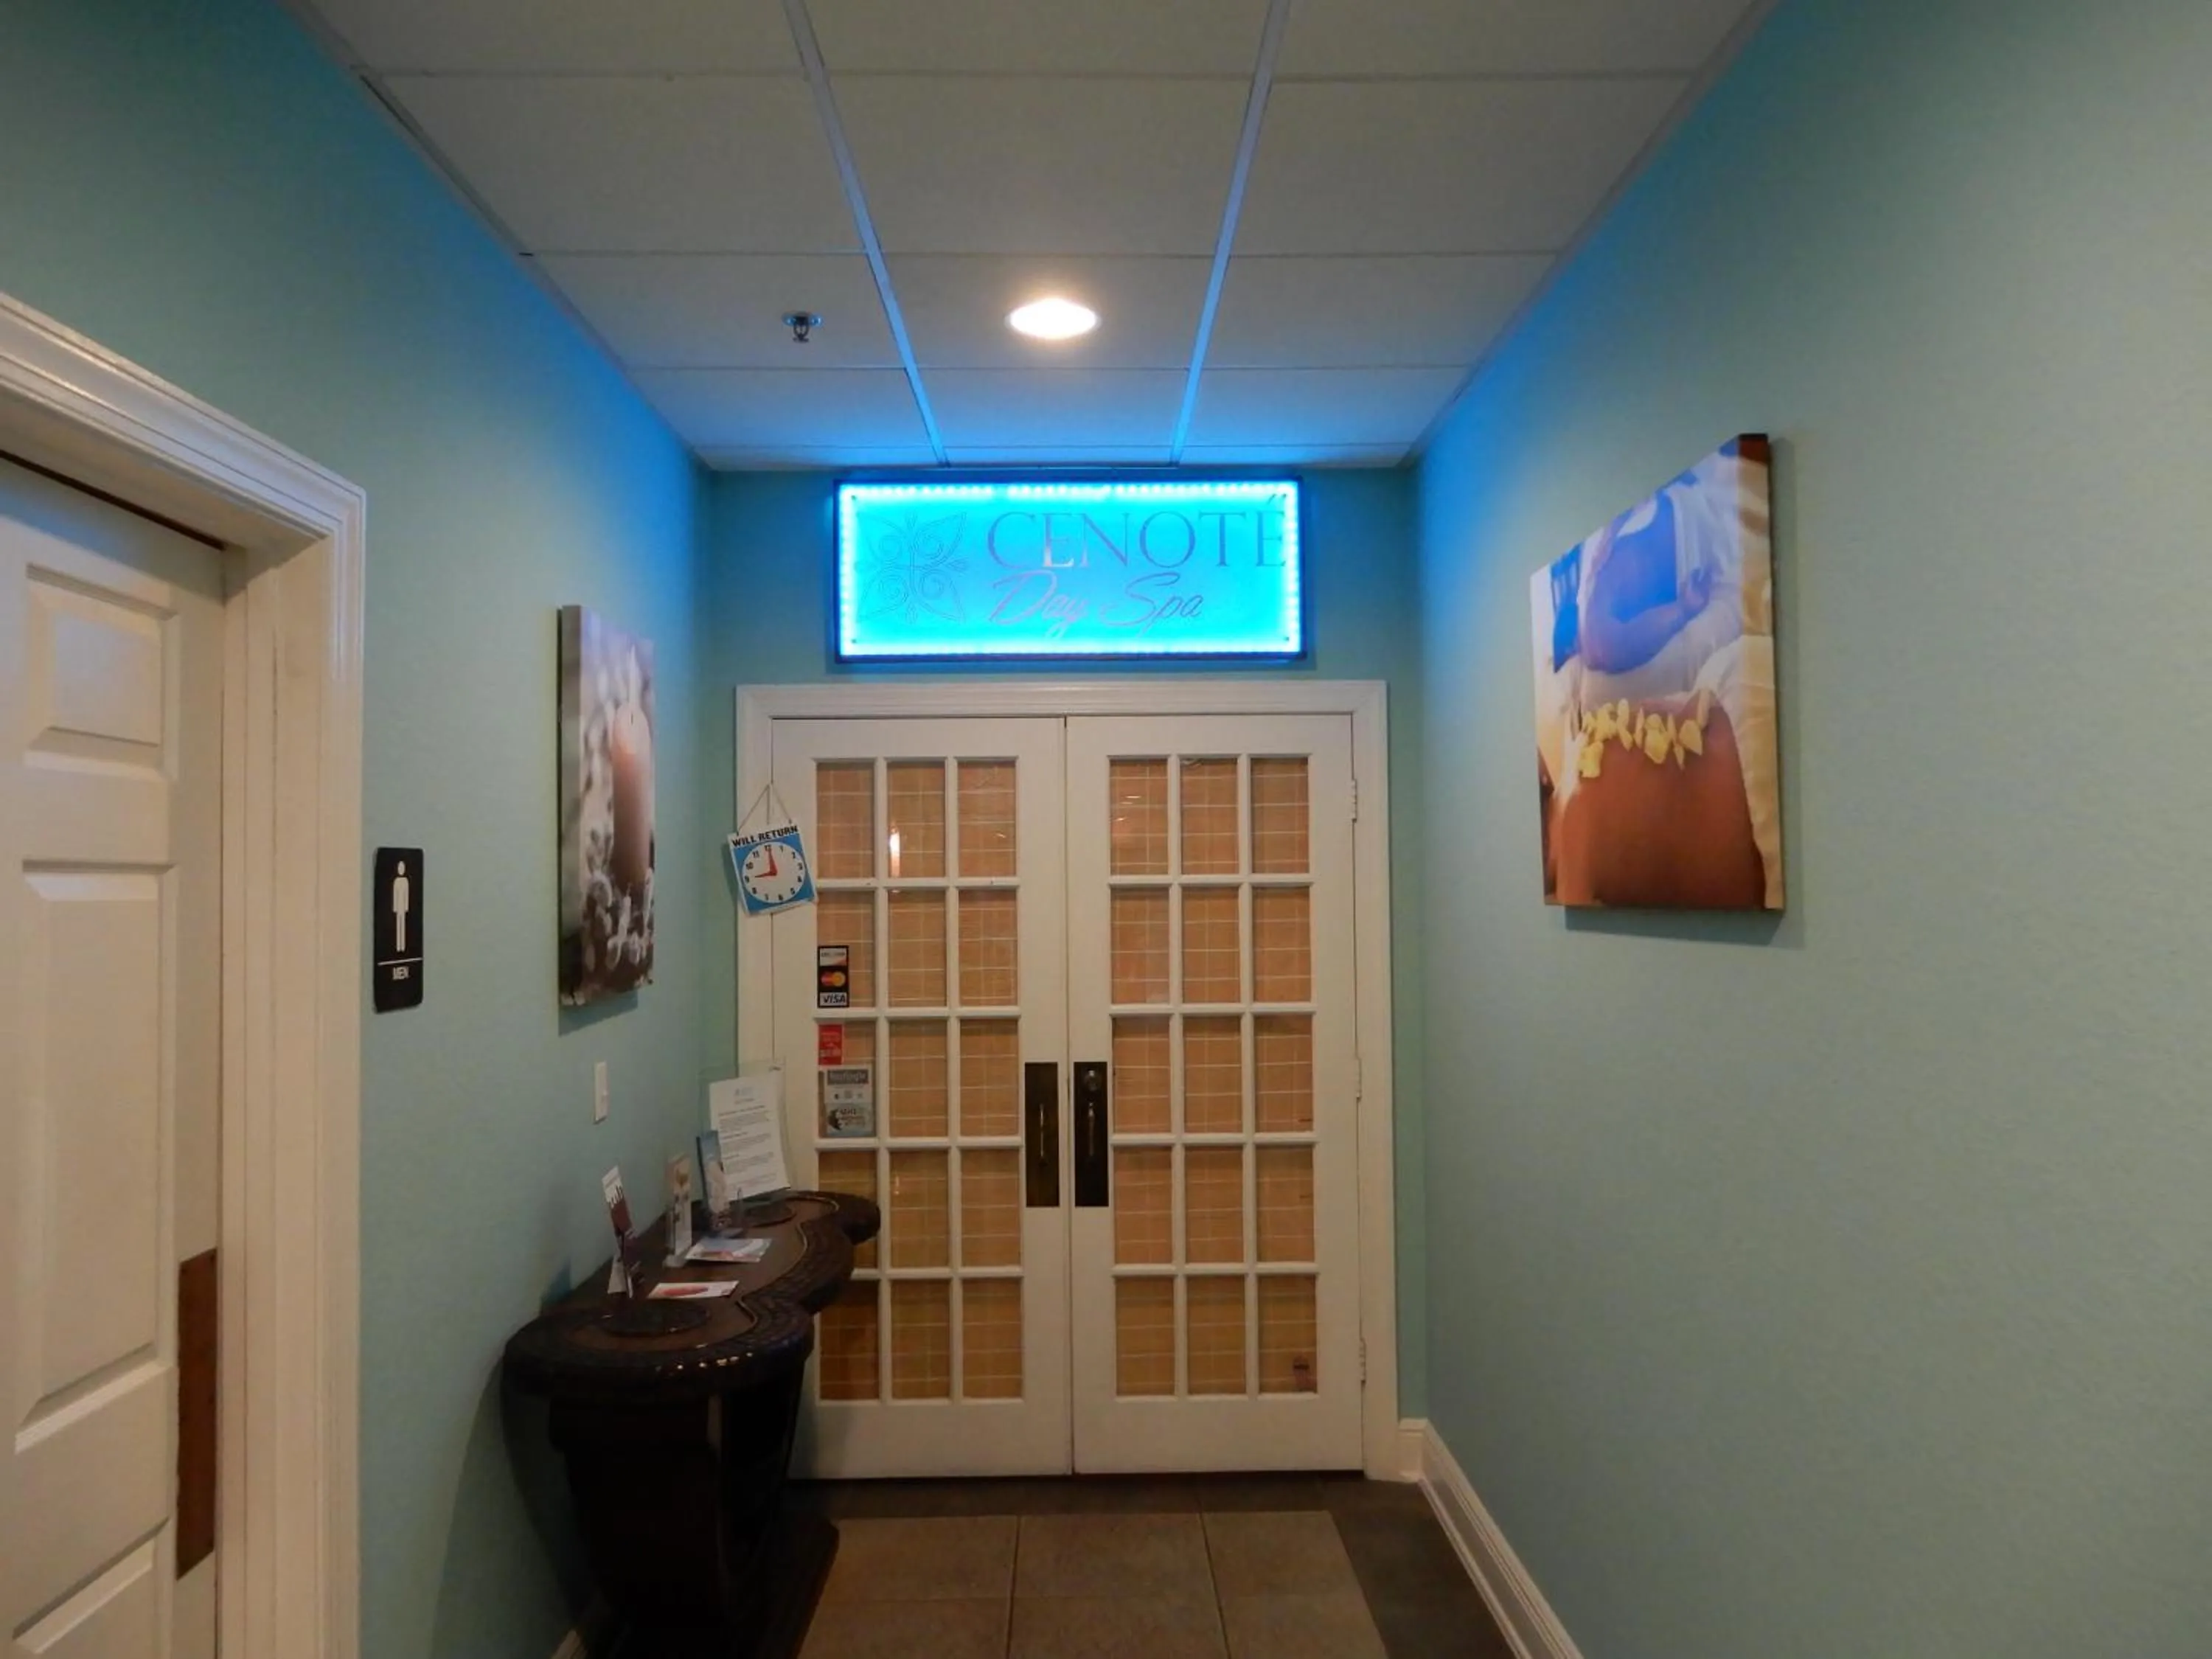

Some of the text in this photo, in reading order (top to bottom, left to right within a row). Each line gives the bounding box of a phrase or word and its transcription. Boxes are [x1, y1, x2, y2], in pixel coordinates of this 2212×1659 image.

[987, 570, 1204, 639] Day Spa
[731, 825, 798, 847] WILL RETURN
[824, 994, 846, 1004] VISA
